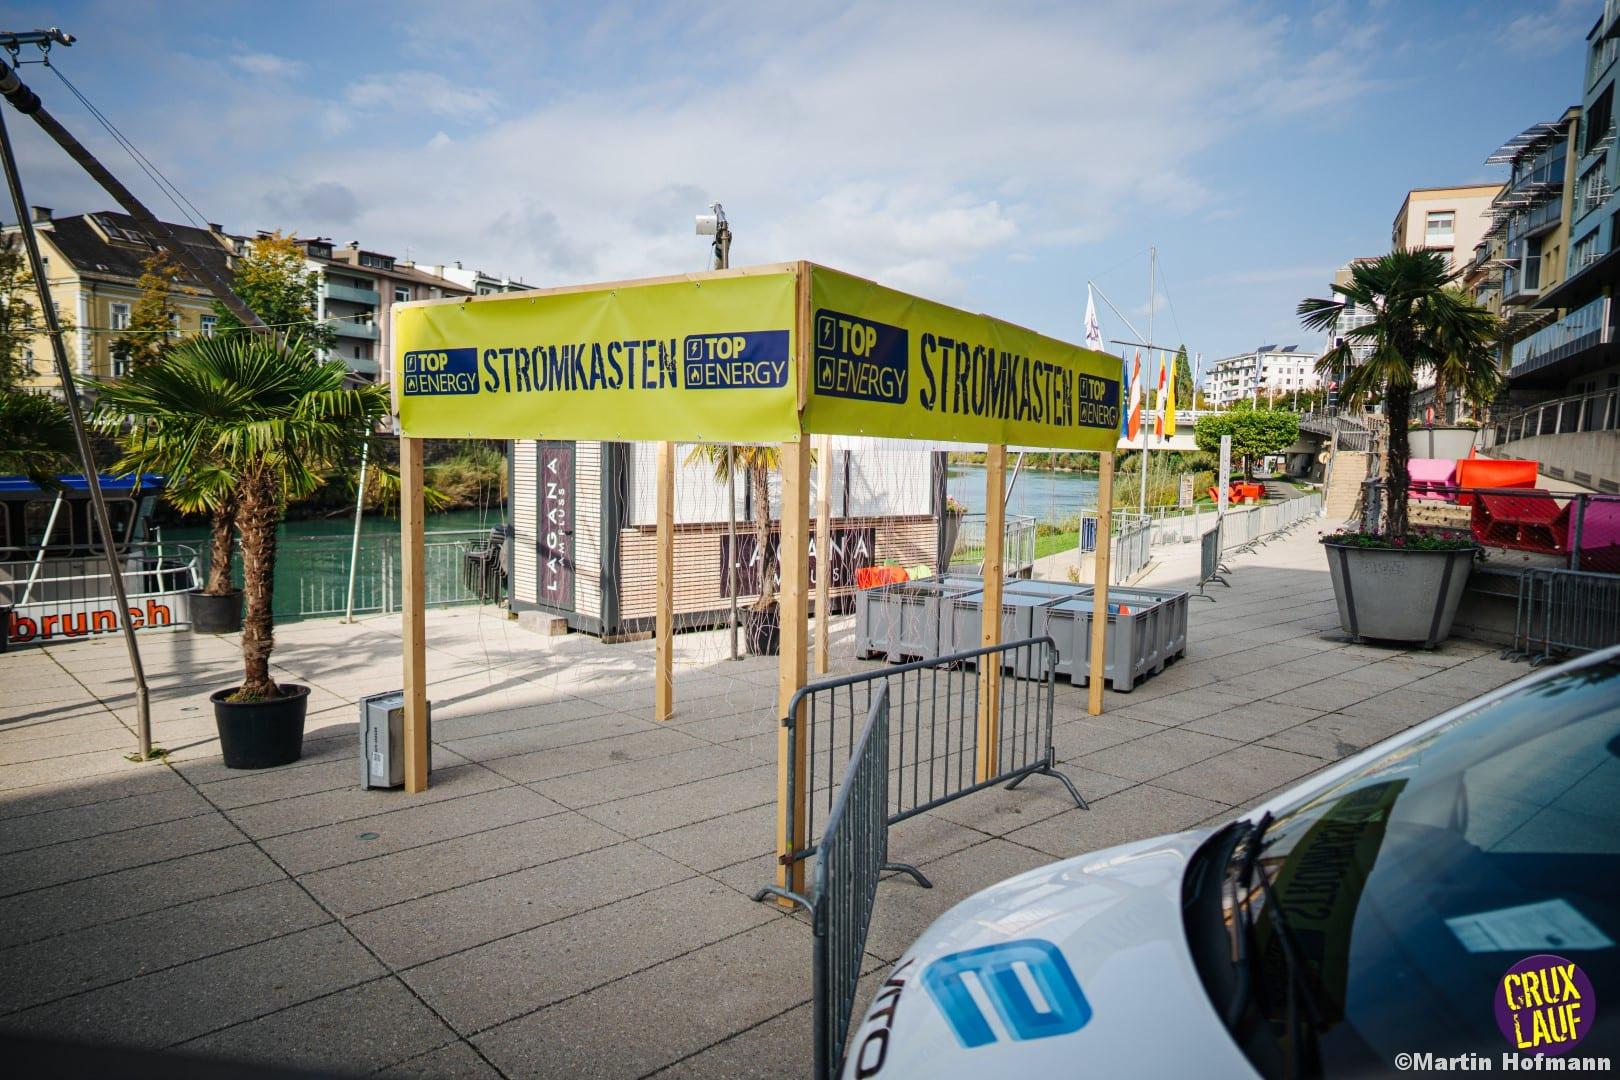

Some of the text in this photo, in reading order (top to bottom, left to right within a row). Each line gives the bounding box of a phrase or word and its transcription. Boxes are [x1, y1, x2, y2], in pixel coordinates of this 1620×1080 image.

[705, 336, 746, 360] TOP
[838, 319, 877, 357] TOP
[418, 353, 448, 372] TOP
[483, 339, 677, 393] STROMKASTEN
[705, 361, 785, 385] ENERGY
[837, 358, 906, 398] ENERGY
[920, 332, 1073, 427] STROMKASTEN
[419, 373, 476, 393] ENERGY
[1088, 378, 1106, 401] TOP
[547, 458, 558, 591] LAGANA
[557, 488, 565, 566] AM FLUSS
